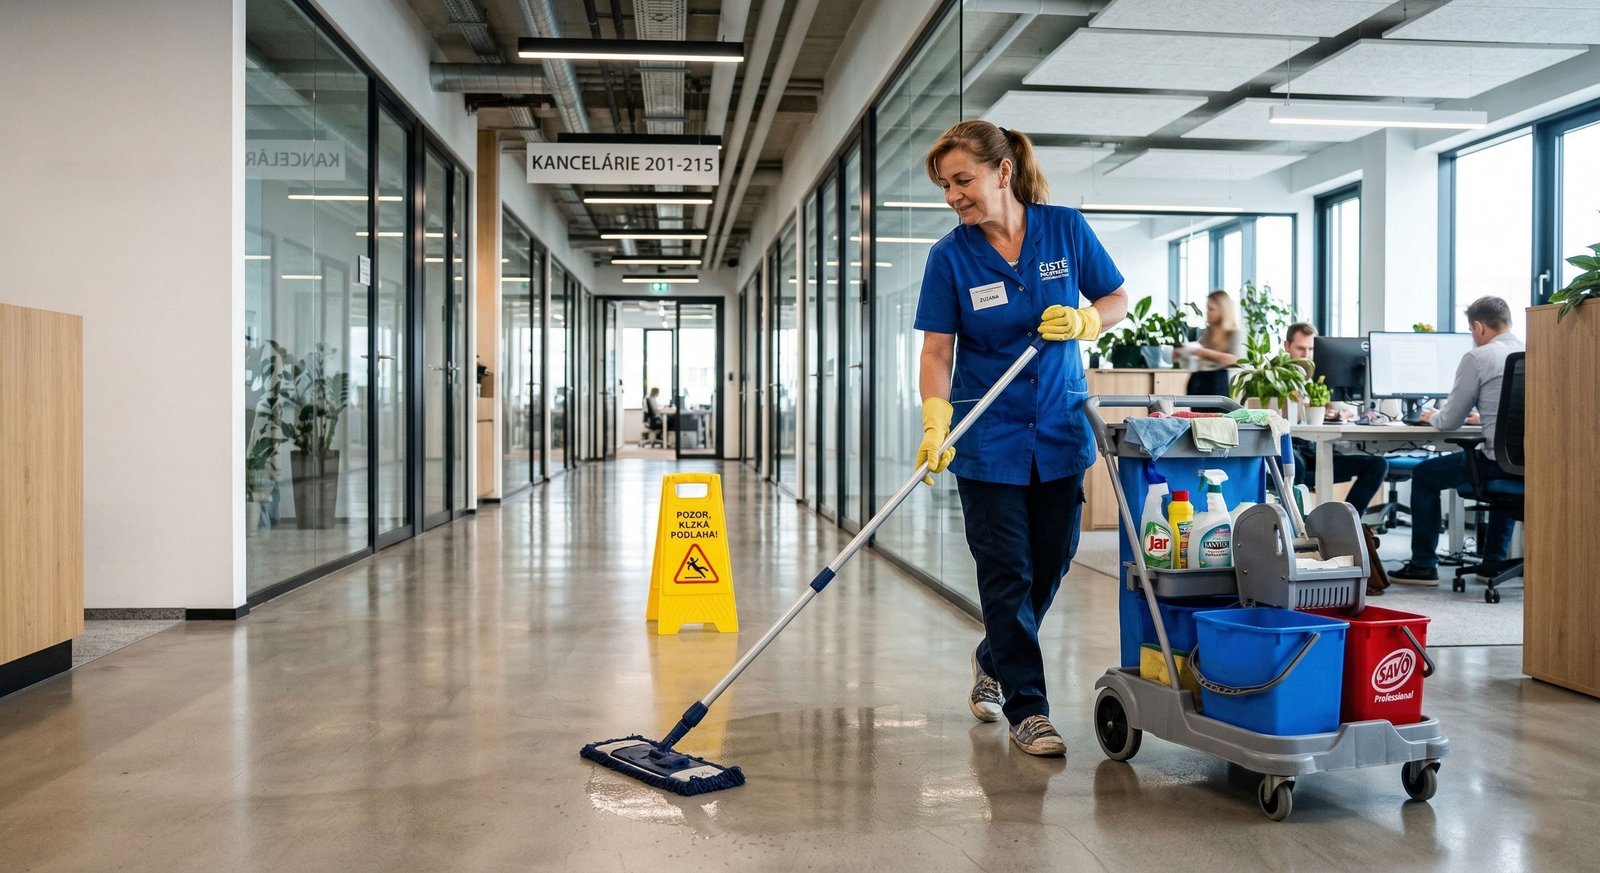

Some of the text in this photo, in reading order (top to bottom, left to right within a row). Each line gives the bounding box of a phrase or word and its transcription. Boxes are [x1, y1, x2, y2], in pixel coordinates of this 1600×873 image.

[532, 153, 713, 172] KANCELÁRIE 201-215
[1039, 257, 1067, 272] ČISTÉ
[676, 511, 712, 520] POZOR,
[670, 531, 718, 539] PODLAHA!
[1148, 535, 1169, 551] Jar
[1379, 653, 1410, 683] SAVO
[1374, 690, 1414, 703] Professional
